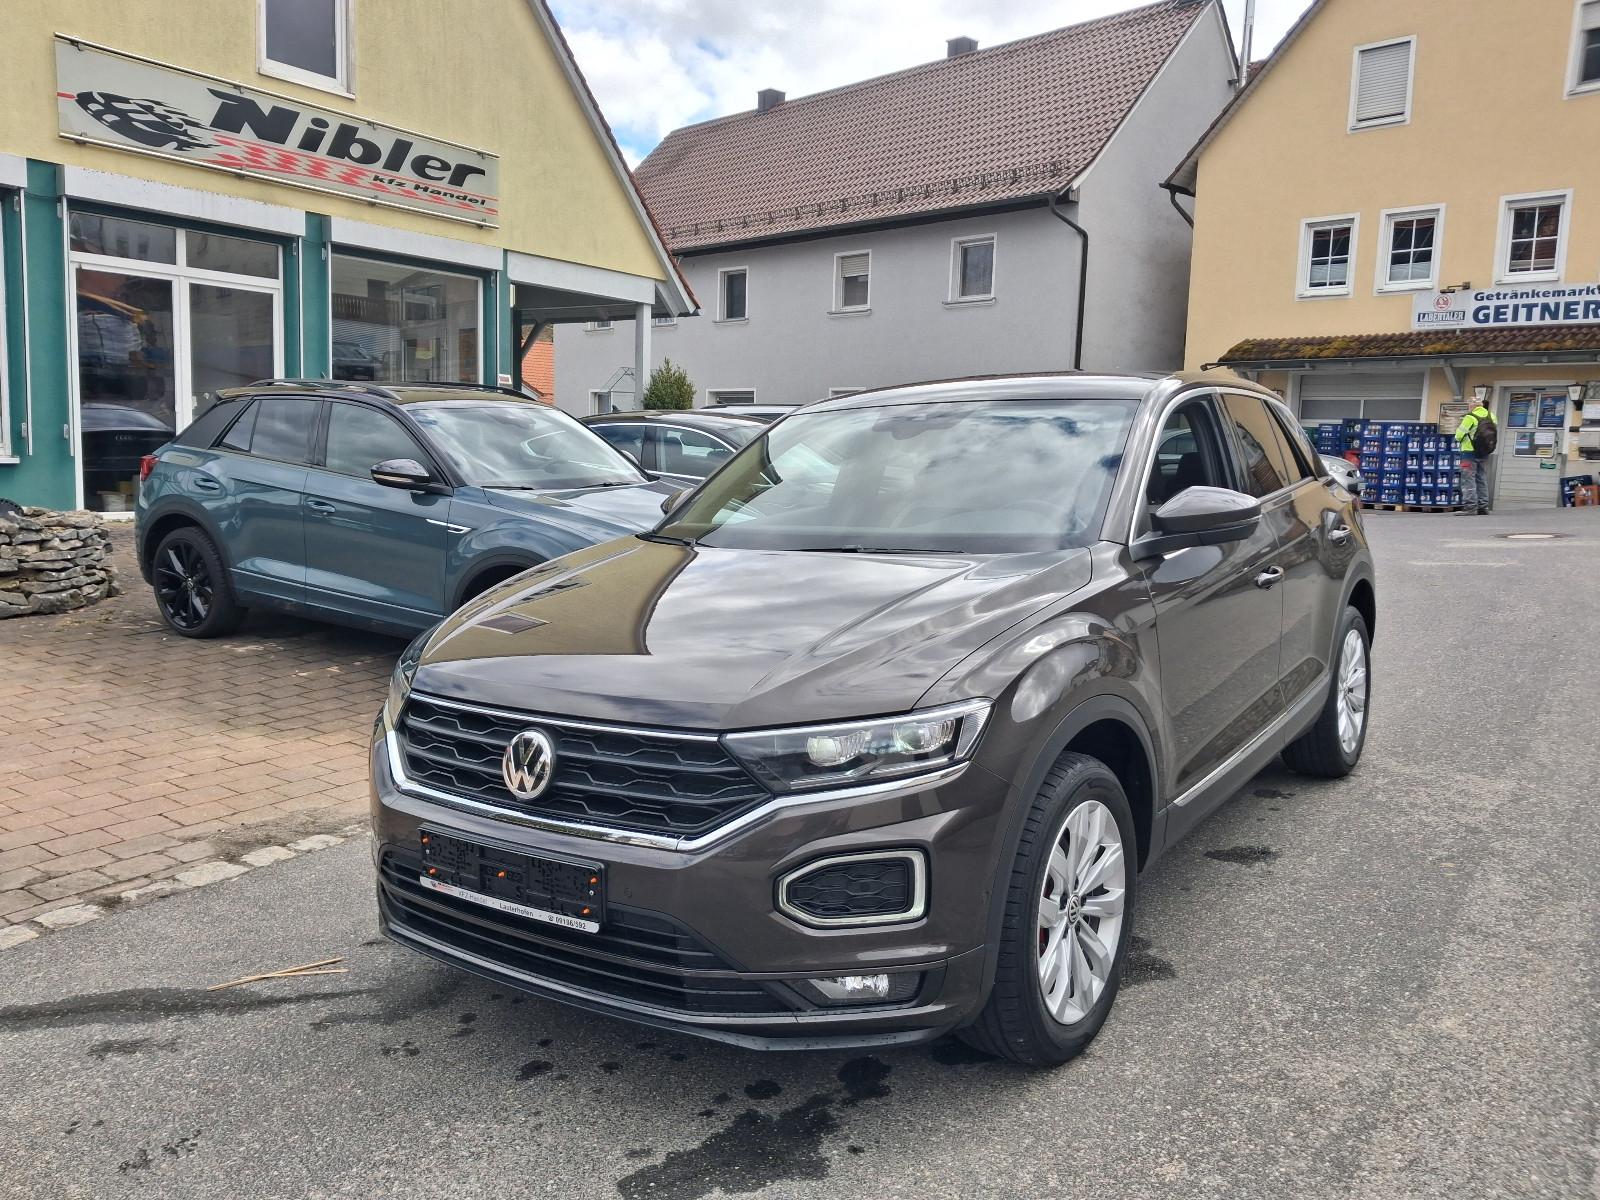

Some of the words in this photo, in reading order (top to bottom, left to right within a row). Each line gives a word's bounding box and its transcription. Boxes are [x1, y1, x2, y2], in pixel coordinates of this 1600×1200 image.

[207, 88, 486, 188] Nibler
[413, 183, 486, 206] Handel
[1419, 311, 1464, 322] LABERTALER
[1472, 300, 1600, 324] GEITNER
[503, 731, 551, 799] VW
